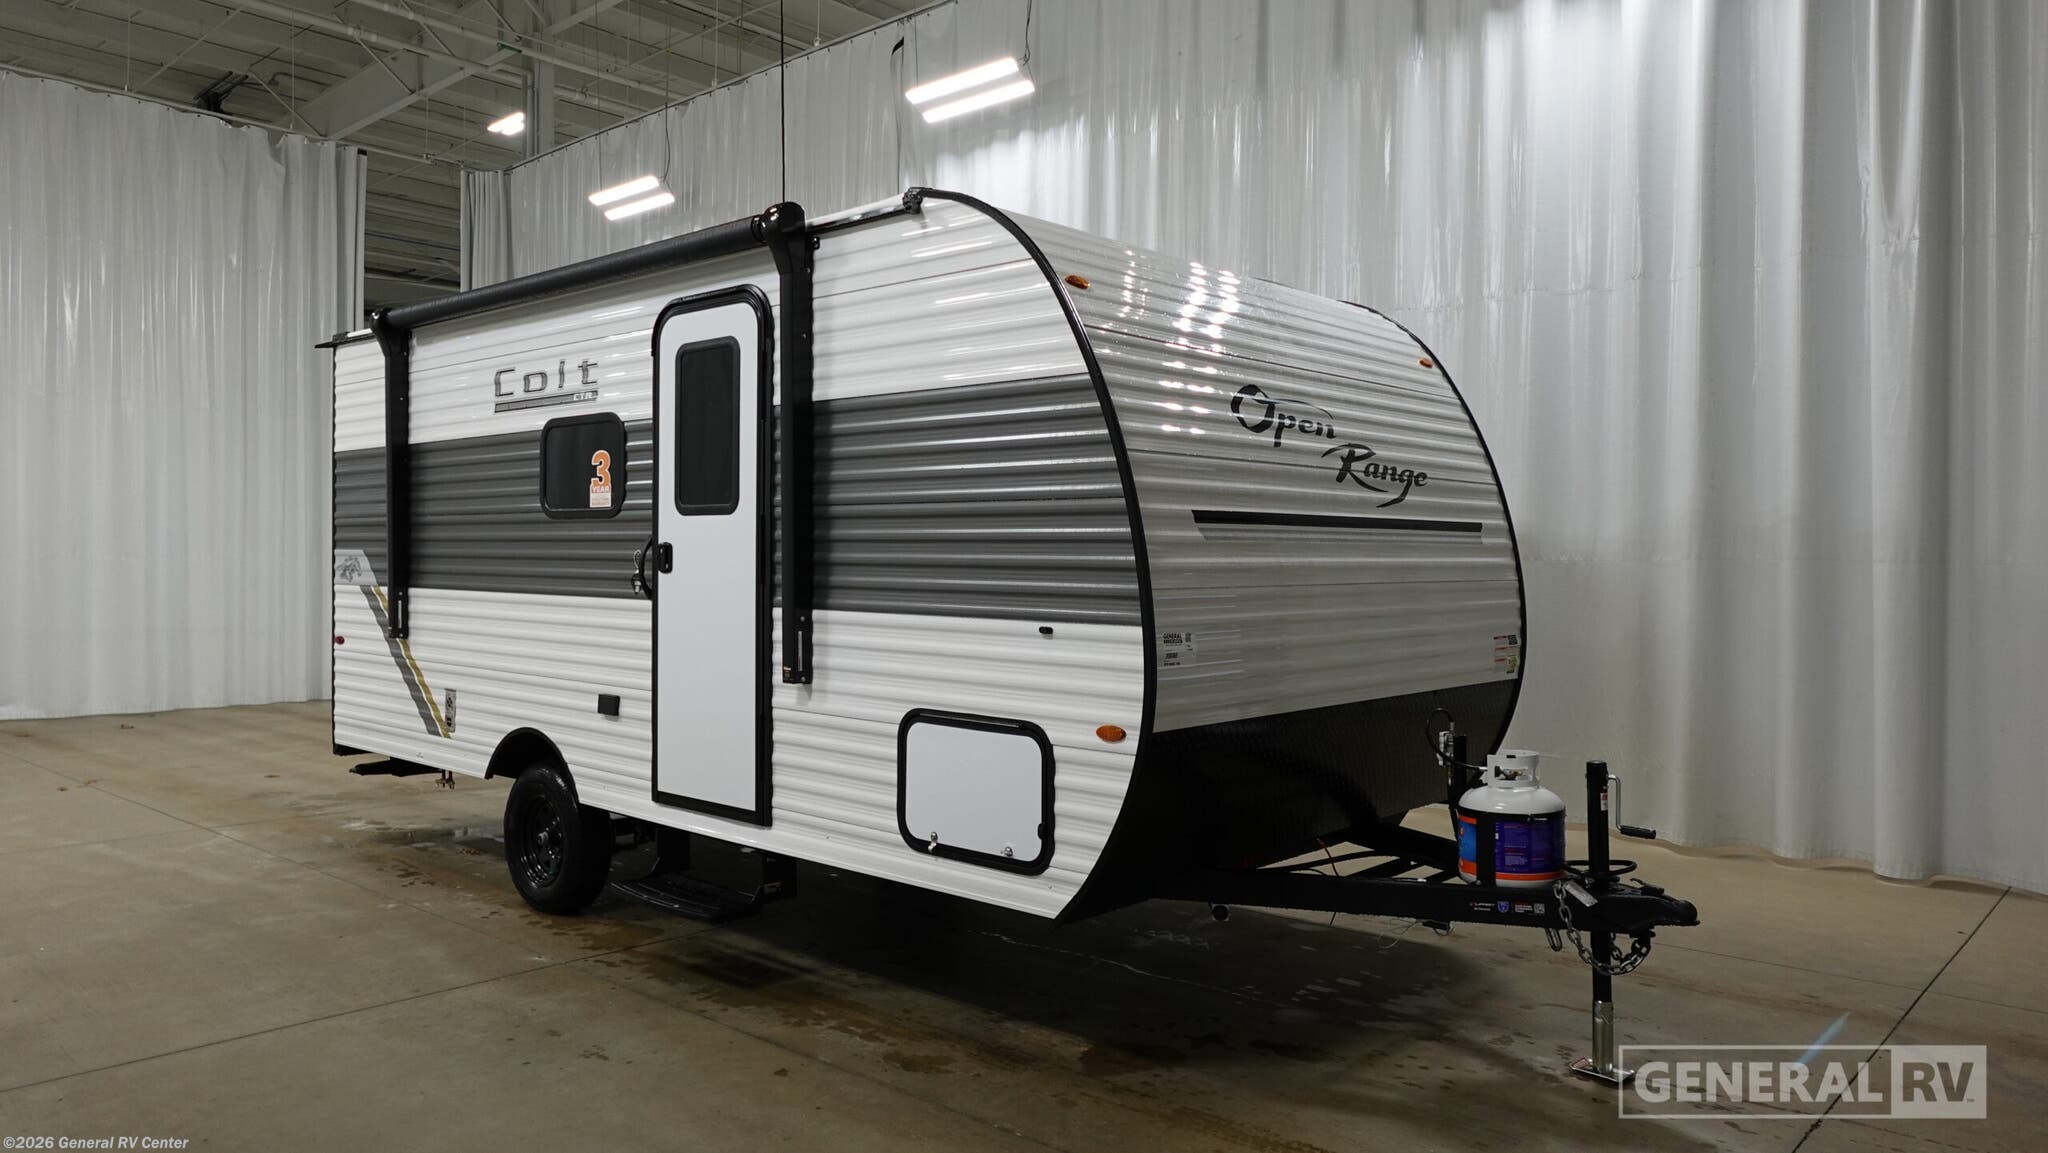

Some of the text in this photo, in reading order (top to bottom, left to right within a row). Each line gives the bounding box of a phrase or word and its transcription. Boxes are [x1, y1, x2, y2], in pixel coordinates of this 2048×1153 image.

[494, 360, 599, 397] Colt
[1231, 384, 1337, 447] Open
[591, 449, 611, 488] 3
[1321, 442, 1428, 508] Range
[592, 485, 610, 493] YEAR
